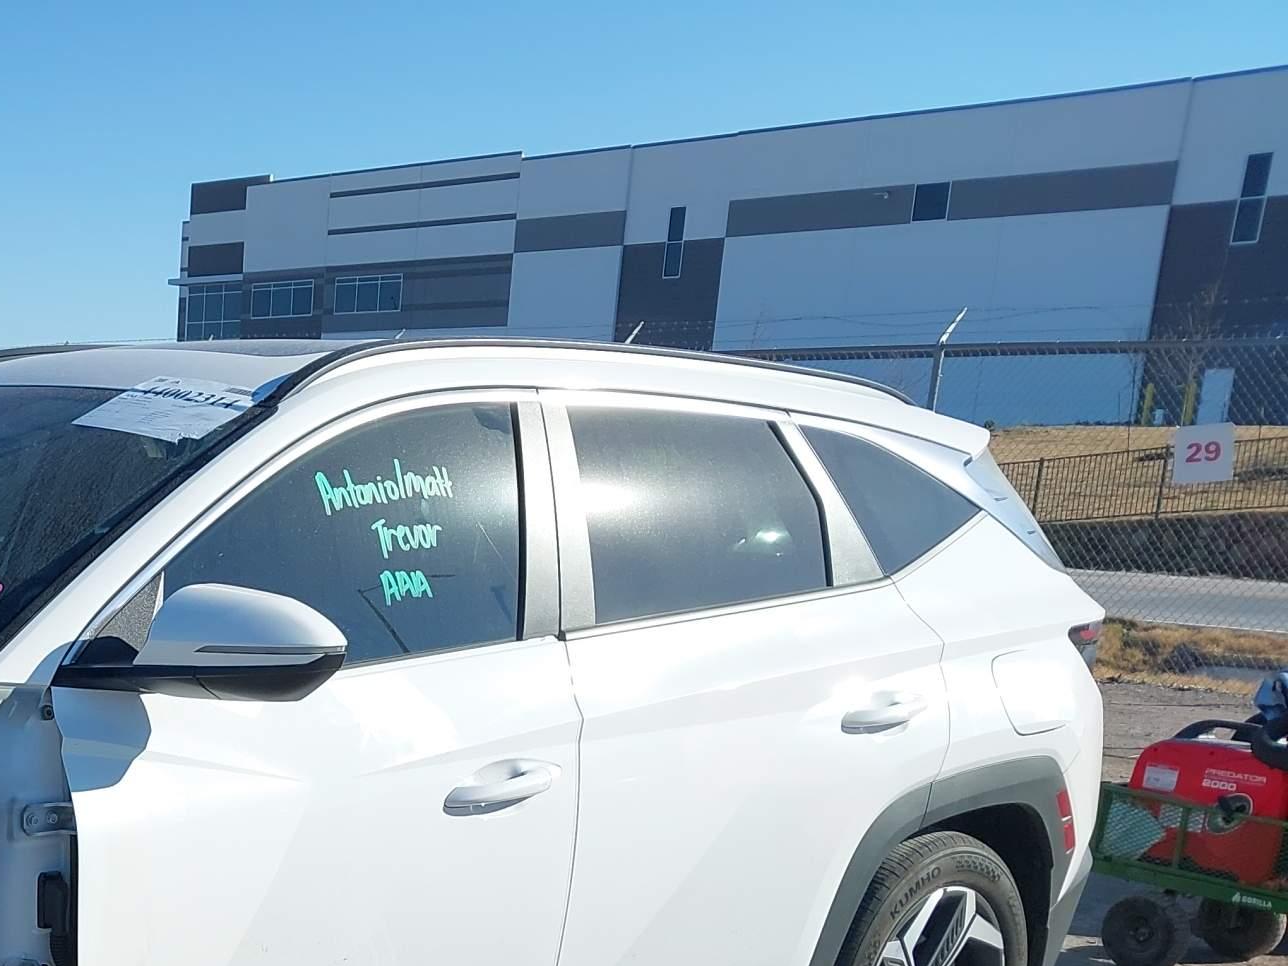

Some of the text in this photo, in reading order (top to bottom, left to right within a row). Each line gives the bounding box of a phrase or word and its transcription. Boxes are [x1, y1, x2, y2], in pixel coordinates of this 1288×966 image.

[1185, 441, 1221, 463] 29
[371, 518, 442, 560] Trevor
[1202, 779, 1237, 791] 2000
[1205, 768, 1267, 784] PREDATOR
[890, 866, 942, 920] KUMHO
